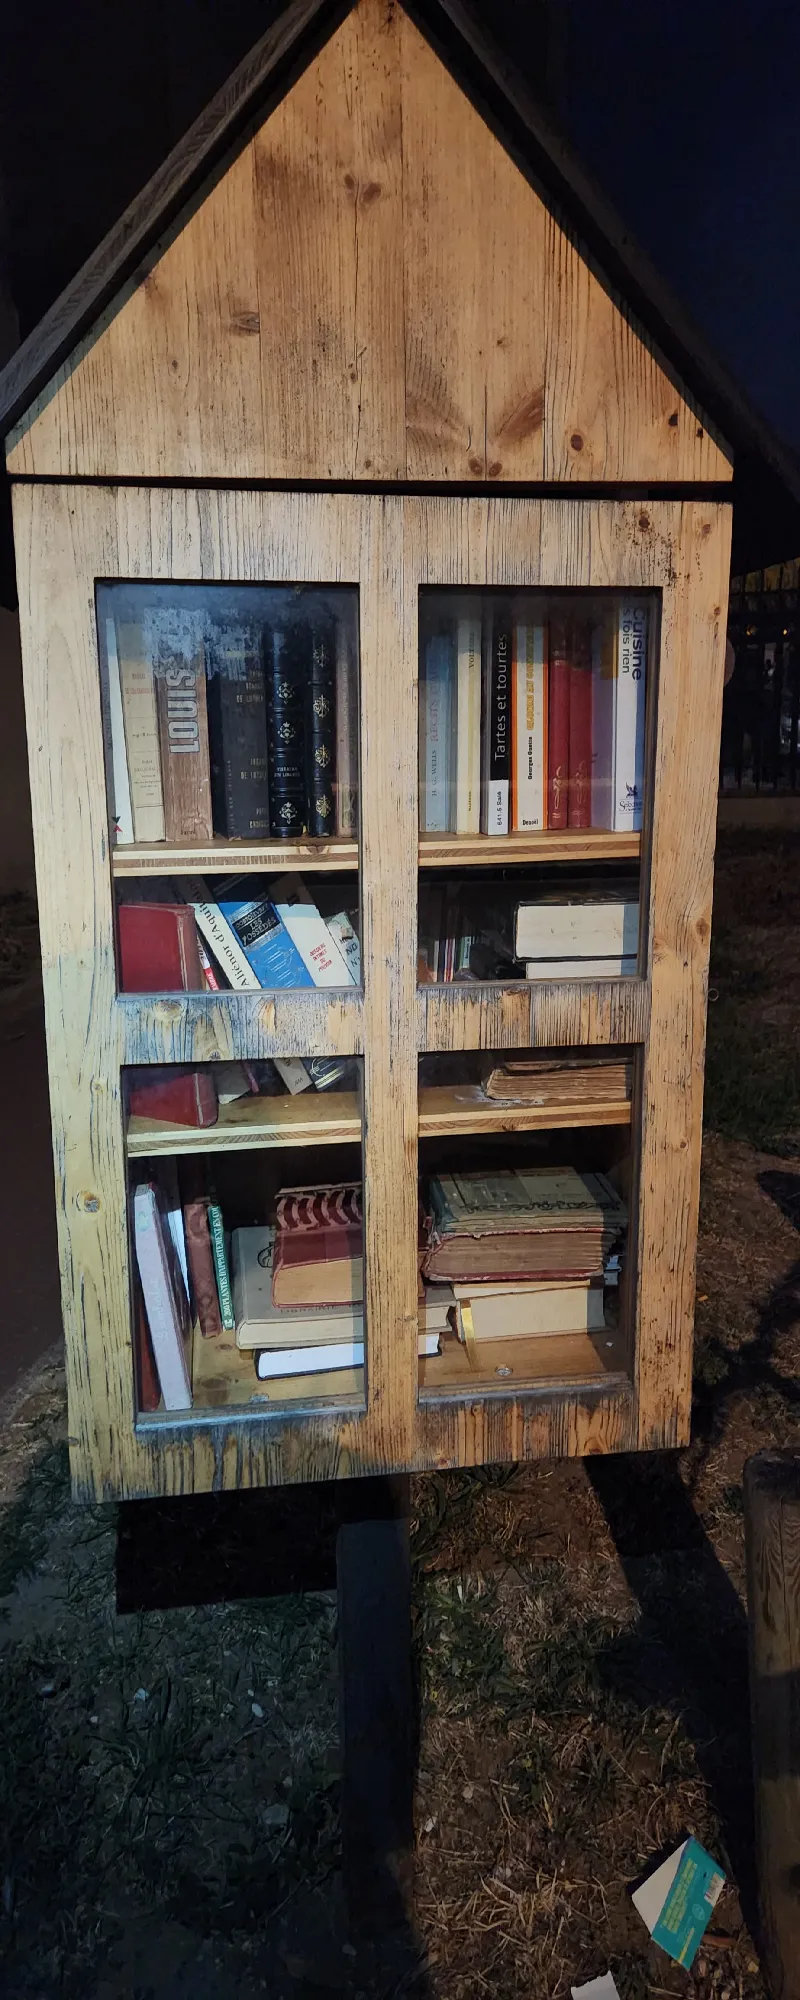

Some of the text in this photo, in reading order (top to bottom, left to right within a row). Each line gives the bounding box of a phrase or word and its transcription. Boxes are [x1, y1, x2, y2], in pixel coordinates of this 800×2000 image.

[622, 620, 632, 644] fois
[632, 607, 645, 680] Cuisine
[622, 649, 632, 673] rien
[165, 668, 200, 754] LOUIS
[495, 633, 508, 761] Tartes et tourtes
[249, 917, 263, 931] LES
[223, 946, 250, 987] Aliénor
[219, 1278, 231, 1305] PLANTES
